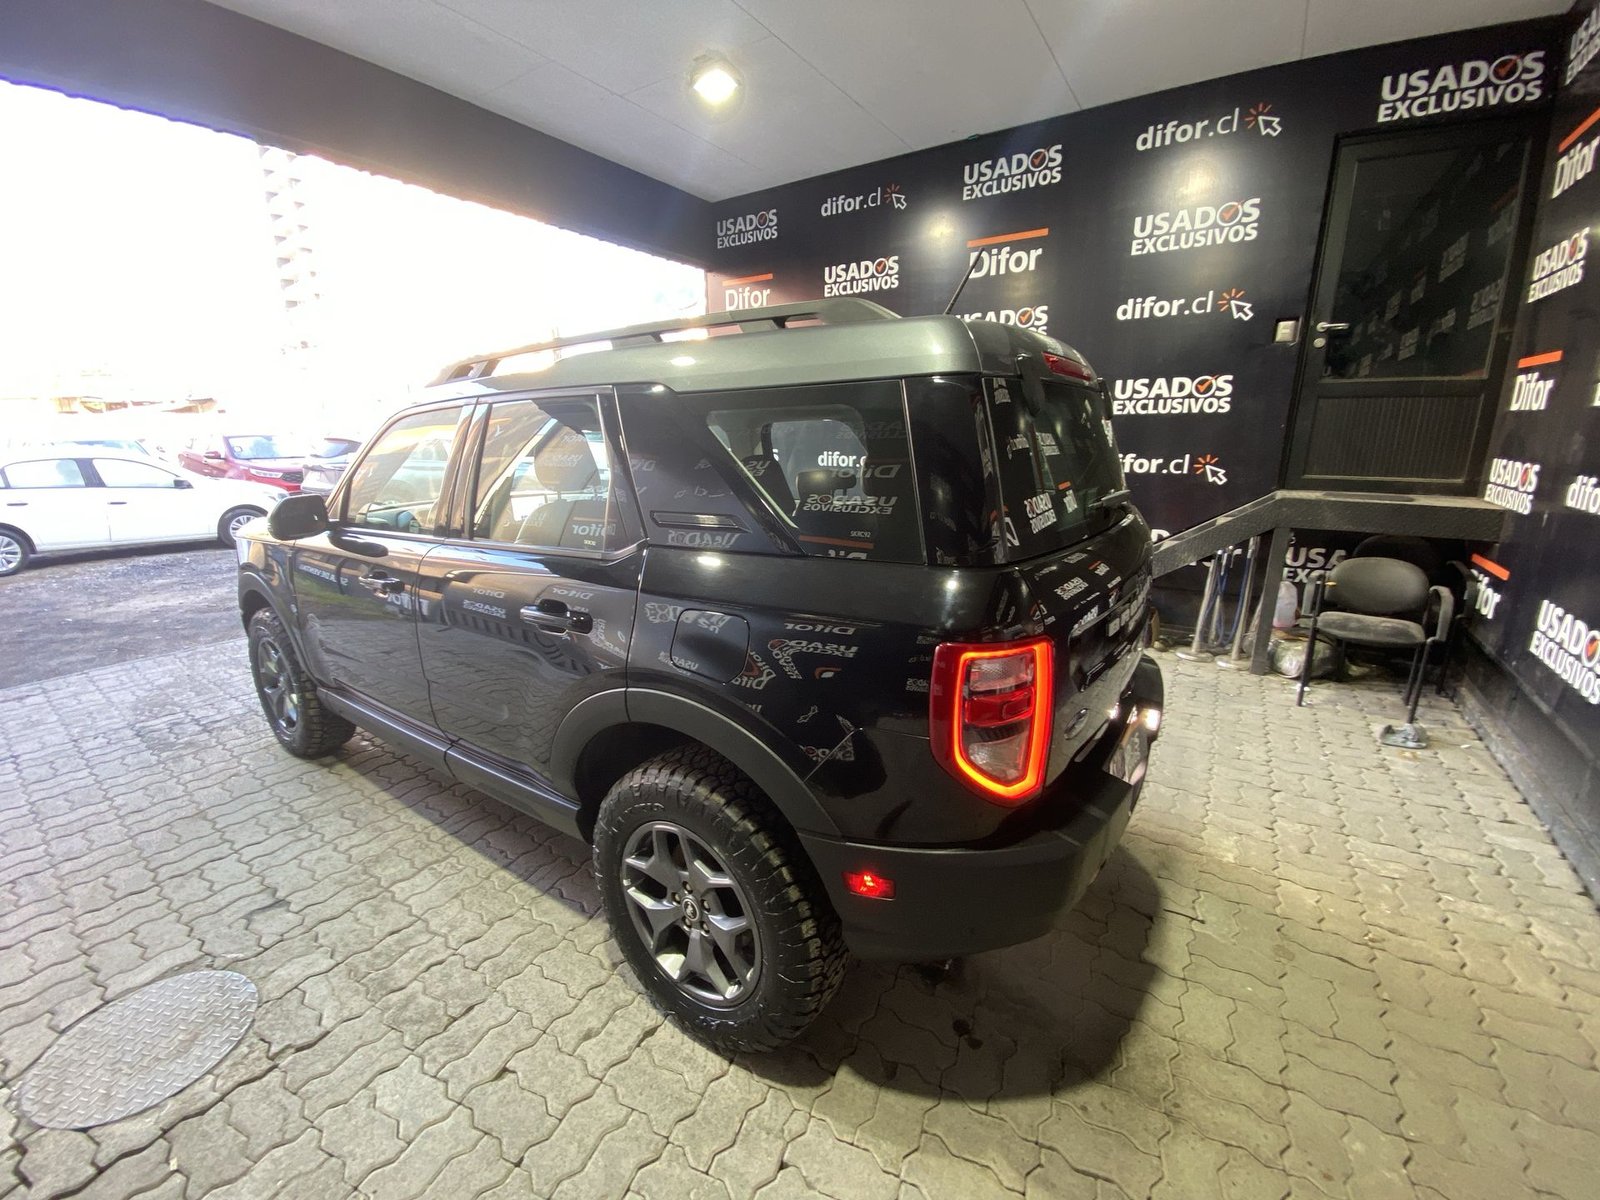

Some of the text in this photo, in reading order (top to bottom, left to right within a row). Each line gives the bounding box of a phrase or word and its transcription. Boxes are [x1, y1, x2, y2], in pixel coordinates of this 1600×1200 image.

[1380, 50, 1545, 101] USADOS
[1377, 80, 1542, 123] EXCLUSIVOS
[1136, 107, 1239, 151] difor.cl
[963, 144, 1063, 184] USADOS
[1552, 136, 1599, 199] Difor
[963, 166, 1061, 200] EXCLUSIVOS
[821, 187, 882, 217] difor.cl
[1133, 198, 1260, 238] USADOS
[716, 209, 778, 237] USADOS
[716, 226, 778, 249] EXCLUSIVOS
[1130, 223, 1258, 256] EXCLUSIVOS
[824, 256, 899, 284] USADOS
[969, 246, 1042, 279] Difor
[1532, 227, 1590, 281] USADOS
[824, 274, 899, 297] EXCLUSIVOS
[1527, 260, 1585, 303] EXCLUSIVOS
[725, 286, 771, 311] Difor
[1116, 290, 1214, 321] difor.cl
[1114, 375, 1233, 400] USADOS
[1509, 372, 1555, 411] Difor
[1113, 397, 1231, 415] EXCLUSIVOS
[1489, 458, 1541, 492] USADOS
[1484, 484, 1534, 515] EXCLUSIVOS
